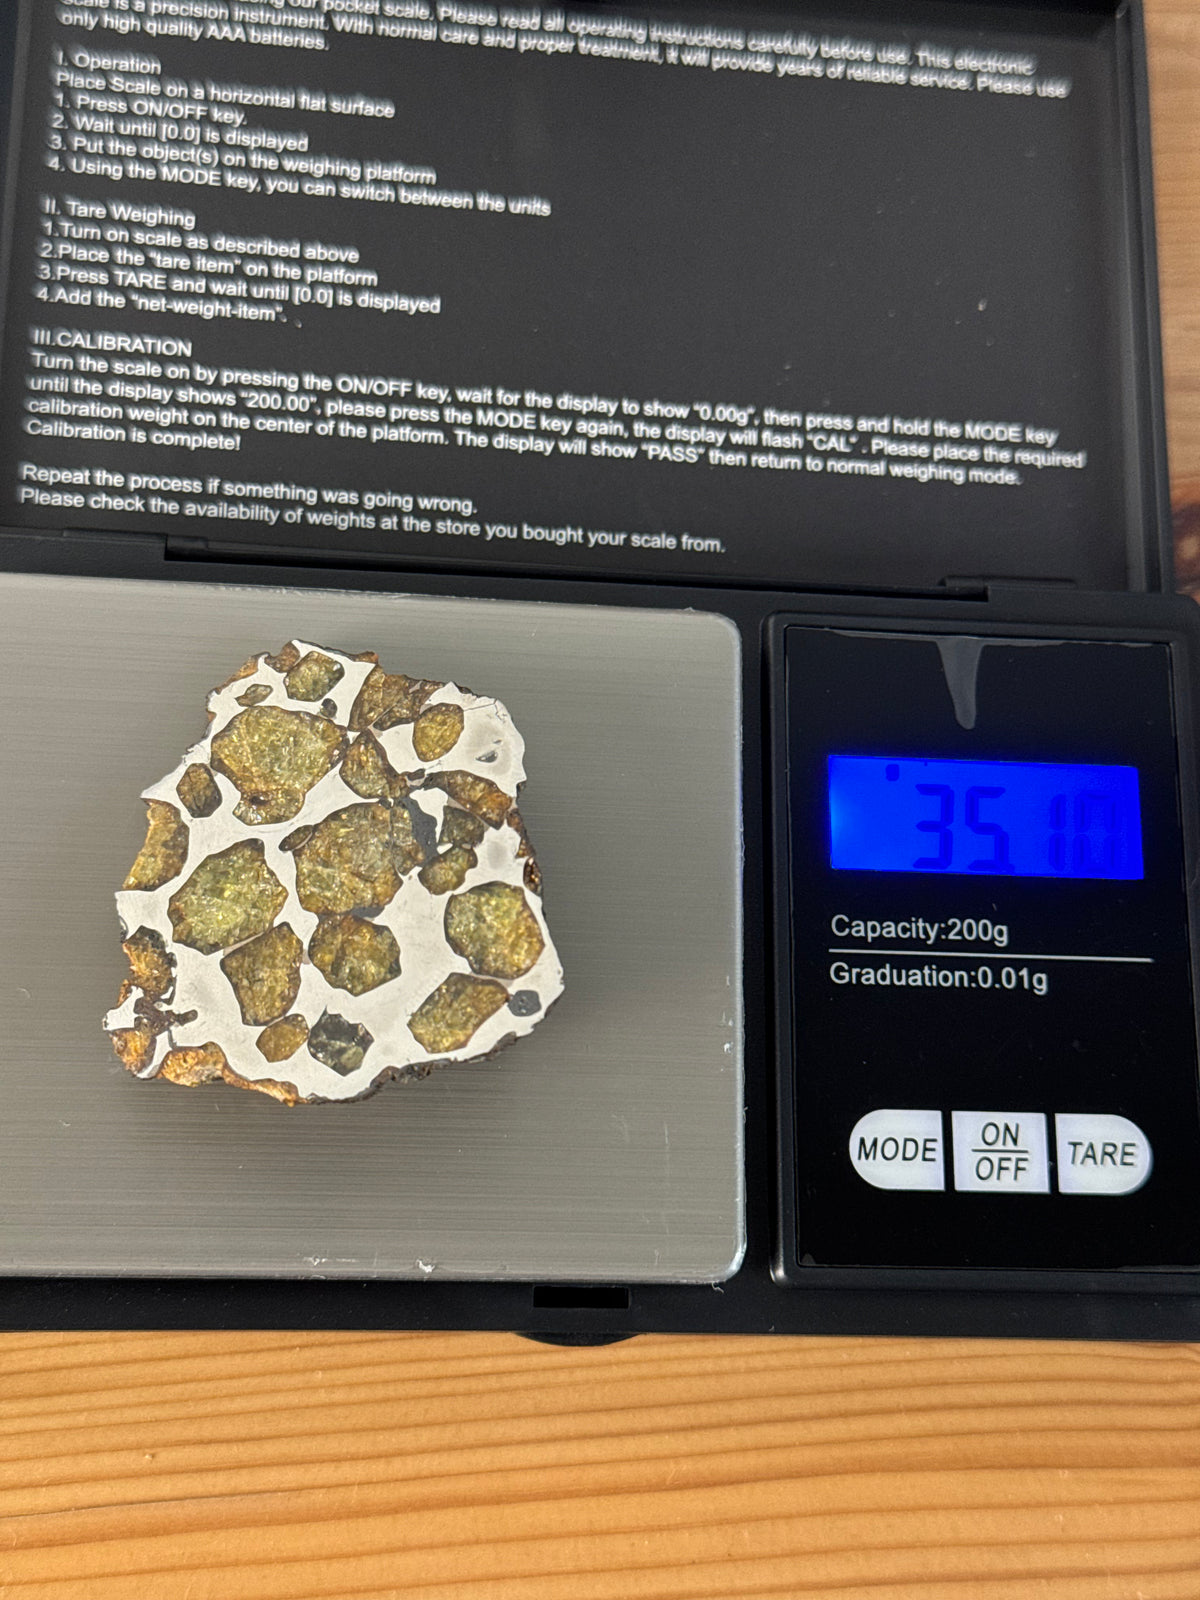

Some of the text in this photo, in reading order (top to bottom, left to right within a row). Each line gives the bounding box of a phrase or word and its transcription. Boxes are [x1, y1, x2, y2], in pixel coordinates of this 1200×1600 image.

[73, 50, 161, 74] Operation
[76, 92, 127, 114] Press
[132, 97, 208, 120] ON/OFF
[74, 113, 114, 133] Wait
[118, 120, 156, 137] until
[205, 126, 220, 143] is
[224, 129, 308, 152] displayed
[71, 135, 103, 154] Put
[107, 137, 136, 157] the
[141, 142, 218, 168] object(s)
[222, 151, 245, 166] on
[249, 150, 278, 170] the
[282, 157, 361, 181] weighing
[364, 163, 436, 184] platform
[71, 157, 123, 181] Using
[126, 161, 156, 180] the
[160, 164, 221, 186] MODE
[225, 170, 261, 192] key,
[265, 177, 299, 195] you
[302, 180, 336, 196] can
[340, 183, 395, 202] switch
[66, 199, 106, 219] Tare
[110, 203, 195, 230] Weighing
[104, 227, 129, 242] on
[133, 230, 182, 248] scale
[186, 235, 208, 250] as
[213, 235, 300, 258] described
[304, 243, 359, 263] above
[114, 247, 145, 266] the
[244, 262, 268, 277] on
[272, 261, 301, 280] the
[305, 266, 377, 286] platform
[95, 290, 125, 308] the
[114, 267, 166, 290] TARE
[171, 277, 206, 294] and
[210, 280, 247, 297] wait
[251, 284, 289, 300] until
[337, 290, 352, 306] is
[356, 291, 440, 315] displayed
[32, 351, 73, 370] Turn
[78, 355, 108, 373] the
[112, 360, 162, 377] scale
[165, 365, 190, 379] on
[194, 364, 218, 385] by
[221, 369, 298, 392] pressing
[303, 373, 332, 391] the
[336, 375, 412, 397] ON/OFF
[417, 383, 451, 403] key,
[456, 388, 492, 404] wait
[496, 388, 521, 406] for
[525, 391, 552, 409] the
[557, 393, 618, 416] display
[622, 398, 639, 415] to
[644, 401, 690, 418] show
[764, 409, 802, 427] then
[806, 414, 853, 431] press
[857, 417, 890, 433] and
[893, 418, 930, 436] hold
[934, 421, 961, 438] the
[965, 422, 1021, 443] MODE
[1026, 427, 1057, 448] key
[27, 419, 240, 451] Calibration is complete!
[30, 376, 69, 392] until
[72, 378, 102, 395] the
[107, 380, 173, 404] display
[176, 386, 236, 406] shows
[325, 399, 386, 418] please
[390, 405, 439, 422] press
[444, 407, 472, 425] the
[477, 408, 536, 430] MODE
[540, 415, 572, 435] key
[576, 420, 628, 438] again,
[633, 421, 661, 439] the
[665, 423, 726, 446] display
[729, 429, 758, 445] will
[762, 429, 803, 449] flash
[872, 437, 930, 458] Please
[933, 443, 980, 462] place
[984, 445, 1012, 464] the
[1015, 450, 1085, 469] required
[28, 398, 123, 419] calibration
[127, 407, 188, 427] weight
[192, 412, 216, 427] on
[221, 412, 250, 429] the
[254, 417, 312, 434] center
[316, 419, 335, 436] of
[338, 421, 367, 439] the
[371, 424, 448, 445] platform.
[454, 429, 488, 448] The
[492, 433, 555, 456] display
[558, 438, 586, 455] will
[591, 440, 637, 458] show
[709, 448, 747, 466] then
[751, 453, 802, 470] return
[806, 455, 823, 472] to
[827, 459, 886, 476] normal
[889, 463, 965, 485] weighing
[969, 468, 1020, 485] mode.
[23, 464, 477, 517] Repeat the process if something was going wrong.
[21, 487, 724, 552] Please check the availability of weights at the store you bought your scale from.
[831, 914, 1009, 947] Capacity:200g
[829, 962, 1048, 995] Graduation:0.01g
[858, 1137, 938, 1162] MODE
[981, 1122, 1019, 1146] ON
[975, 1156, 1028, 1181] OFF
[1067, 1141, 1137, 1166] TARE
